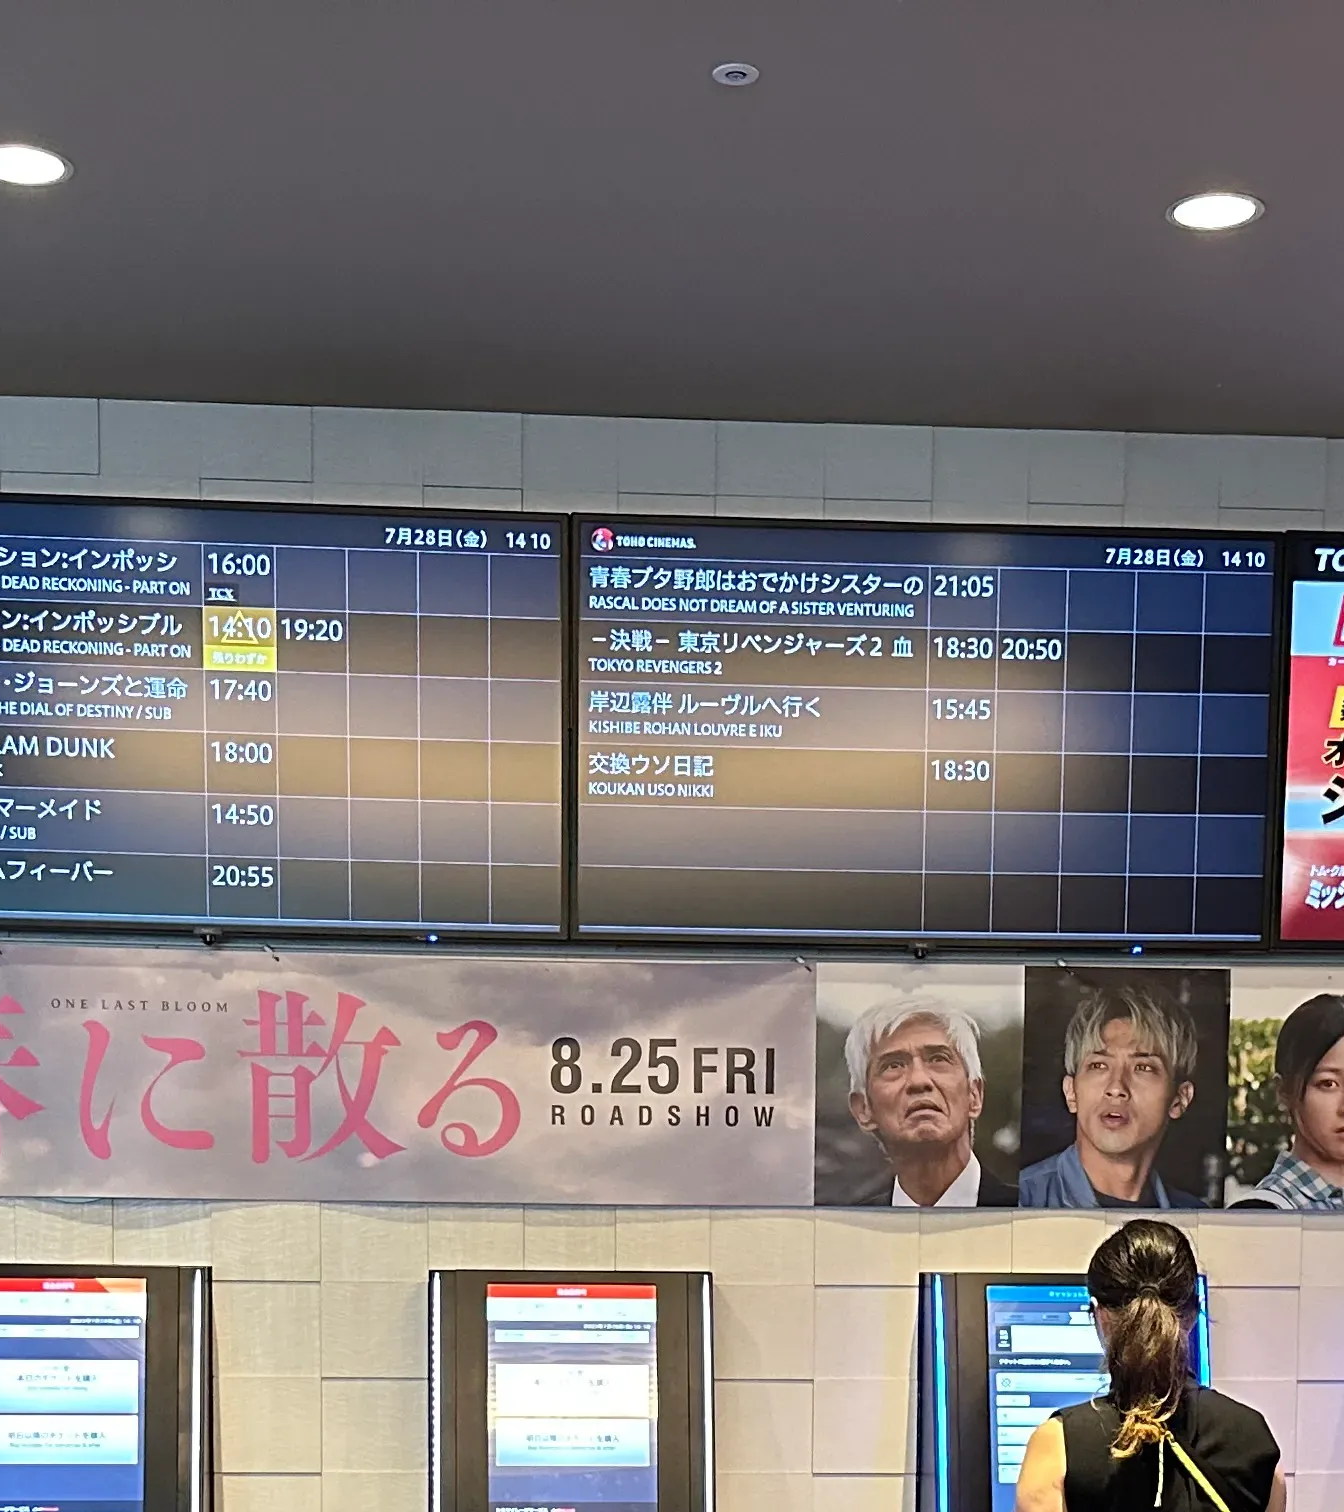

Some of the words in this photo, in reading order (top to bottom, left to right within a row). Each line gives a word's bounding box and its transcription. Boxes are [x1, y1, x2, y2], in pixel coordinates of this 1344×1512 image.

[208, 553, 271, 576] 16:00
[2, 575, 39, 590] DEAD
[42, 576, 123, 593] RECKONING
[132, 580, 167, 594] PART
[170, 581, 191, 595] ON
[589, 566, 924, 596] 青春ブタ野郎はおでかけシスターの
[934, 575, 994, 598] 21:05
[589, 596, 639, 611] RASCAL
[642, 598, 677, 612] DOES
[679, 599, 708, 612] NOT
[710, 600, 757, 614] DREAM
[759, 601, 777, 615] OF
[779, 602, 790, 615] A
[791, 602, 835, 617] SISTER
[837, 603, 914, 618] VENTURING
[209, 616, 272, 639] 14:10
[281, 618, 343, 642] 19:20
[892, 636, 913, 658] 血
[933, 637, 993, 660] 18:30
[1002, 638, 1062, 661] 20:50
[210, 678, 272, 702] 17:40
[589, 691, 673, 715] 岸辺露伴
[678, 693, 822, 719] ルーヴルへ行く
[933, 699, 991, 720] 15:45
[47, 737, 115, 759] DUNK
[211, 742, 273, 764] 18:00
[589, 752, 714, 778] 交換ウソ日記
[931, 759, 990, 782] 18:30
[212, 803, 274, 826] 14:50
[212, 865, 274, 888] 20:55
[51, 998, 88, 1009] ONE
[102, 999, 148, 1010] LAST
[161, 1001, 228, 1012] BLOOM
[548, 1034, 682, 1098] 8.25
[693, 1045, 777, 1096] FRI
[551, 1104, 777, 1129] ROADSHOW
